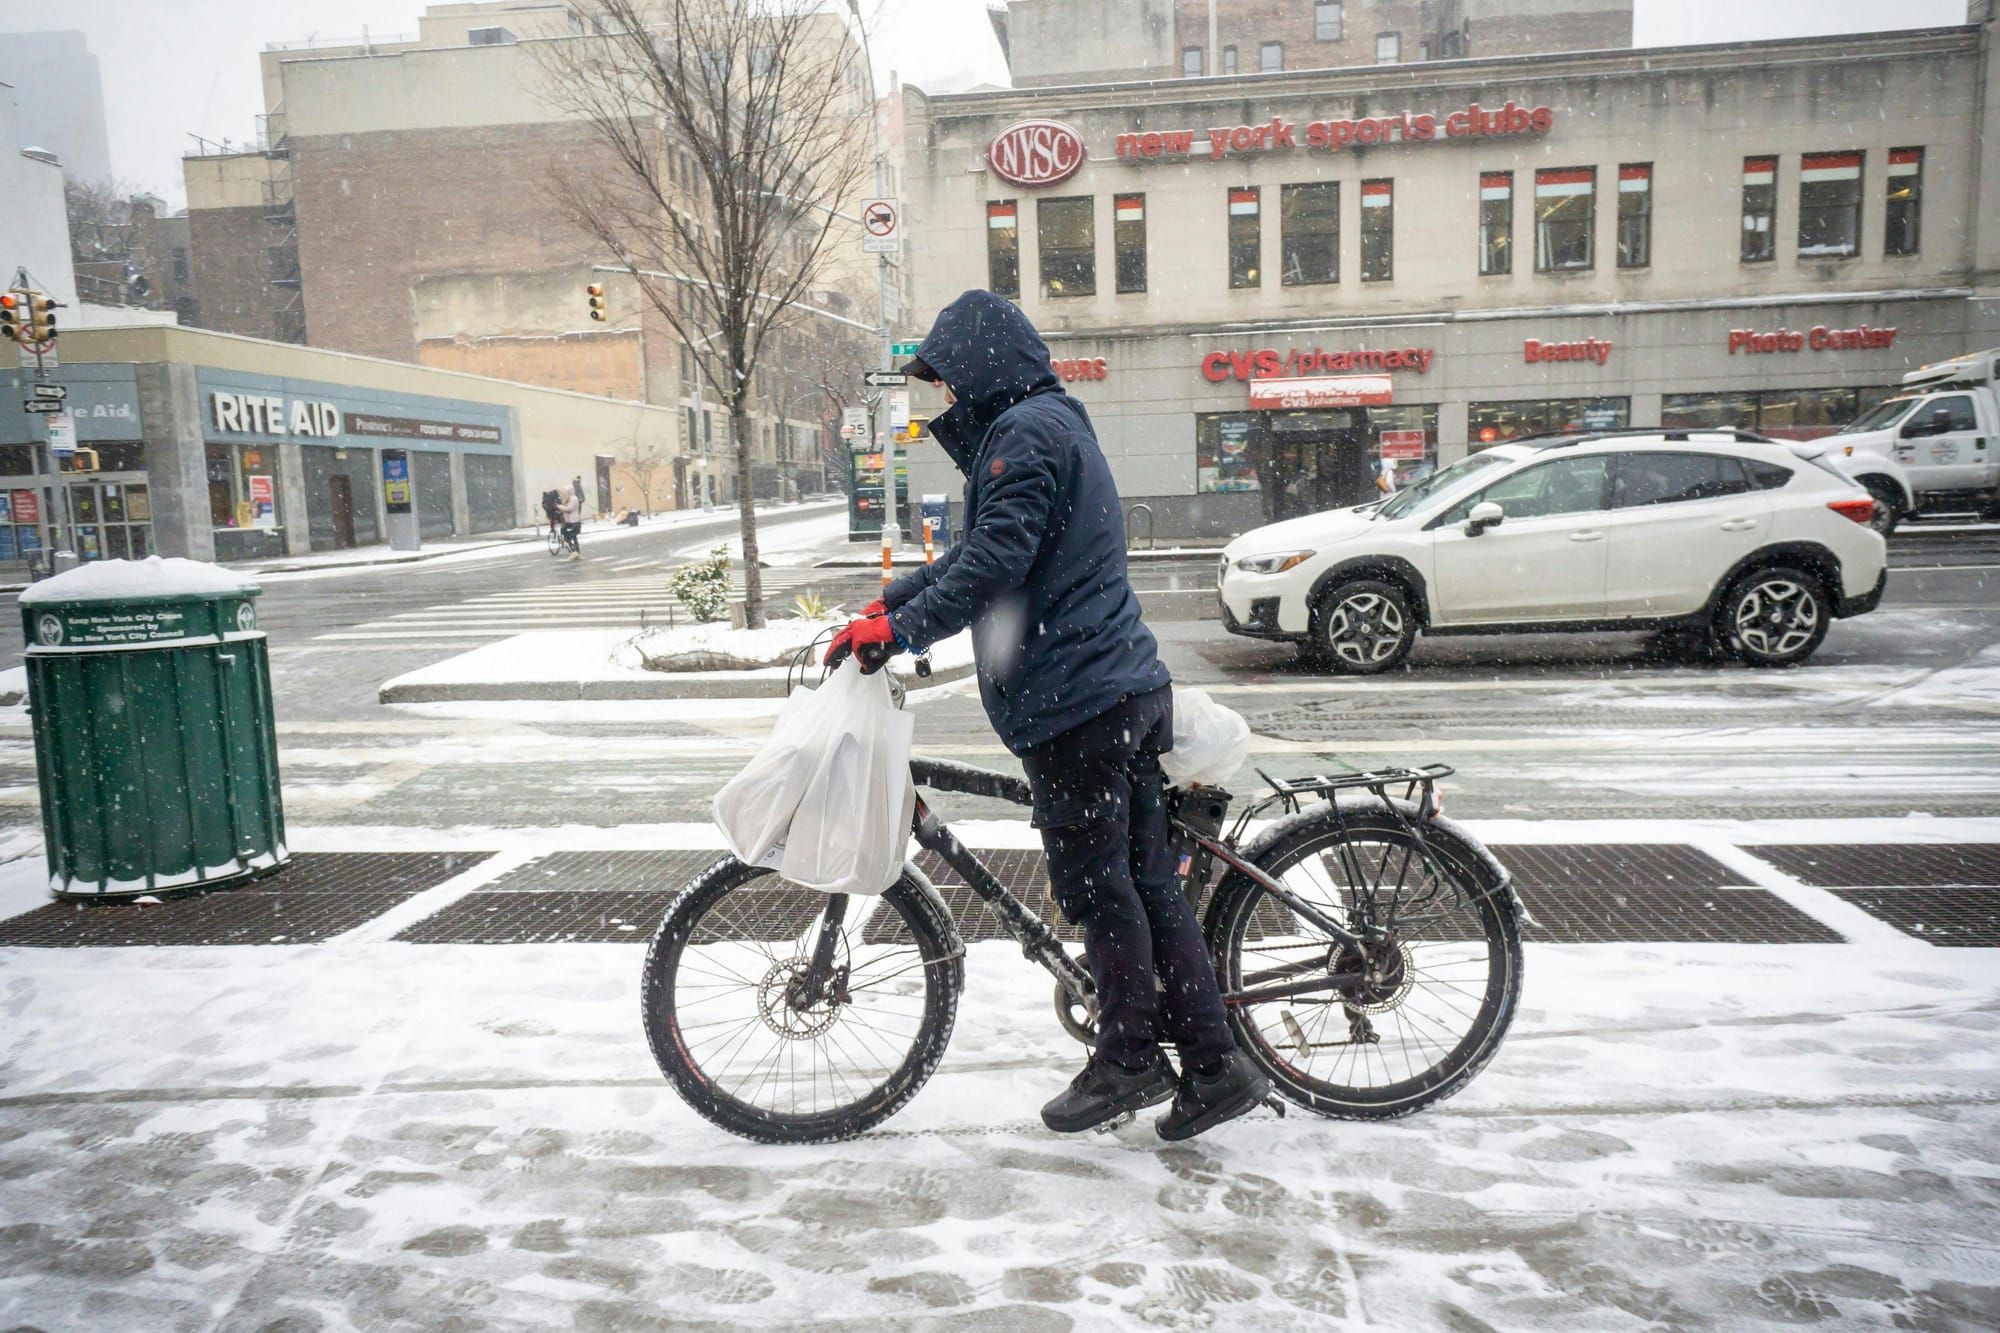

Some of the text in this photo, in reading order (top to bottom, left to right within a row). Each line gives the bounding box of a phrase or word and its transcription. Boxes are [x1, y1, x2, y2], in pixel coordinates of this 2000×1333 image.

[1116, 100, 1553, 160] new york sports clubs
[1002, 127, 1071, 179] NYSC
[1523, 336, 1613, 366] Beauty
[1728, 324, 1897, 354] Photo Center
[1201, 347, 1436, 382] CVS/pharmacy
[93, 403, 131, 418] Aid
[210, 391, 340, 437] RITE AID
[135, 613, 155, 623] City
[147, 623, 158, 631] by
[128, 631, 147, 640] City
[149, 629, 184, 639] Council
